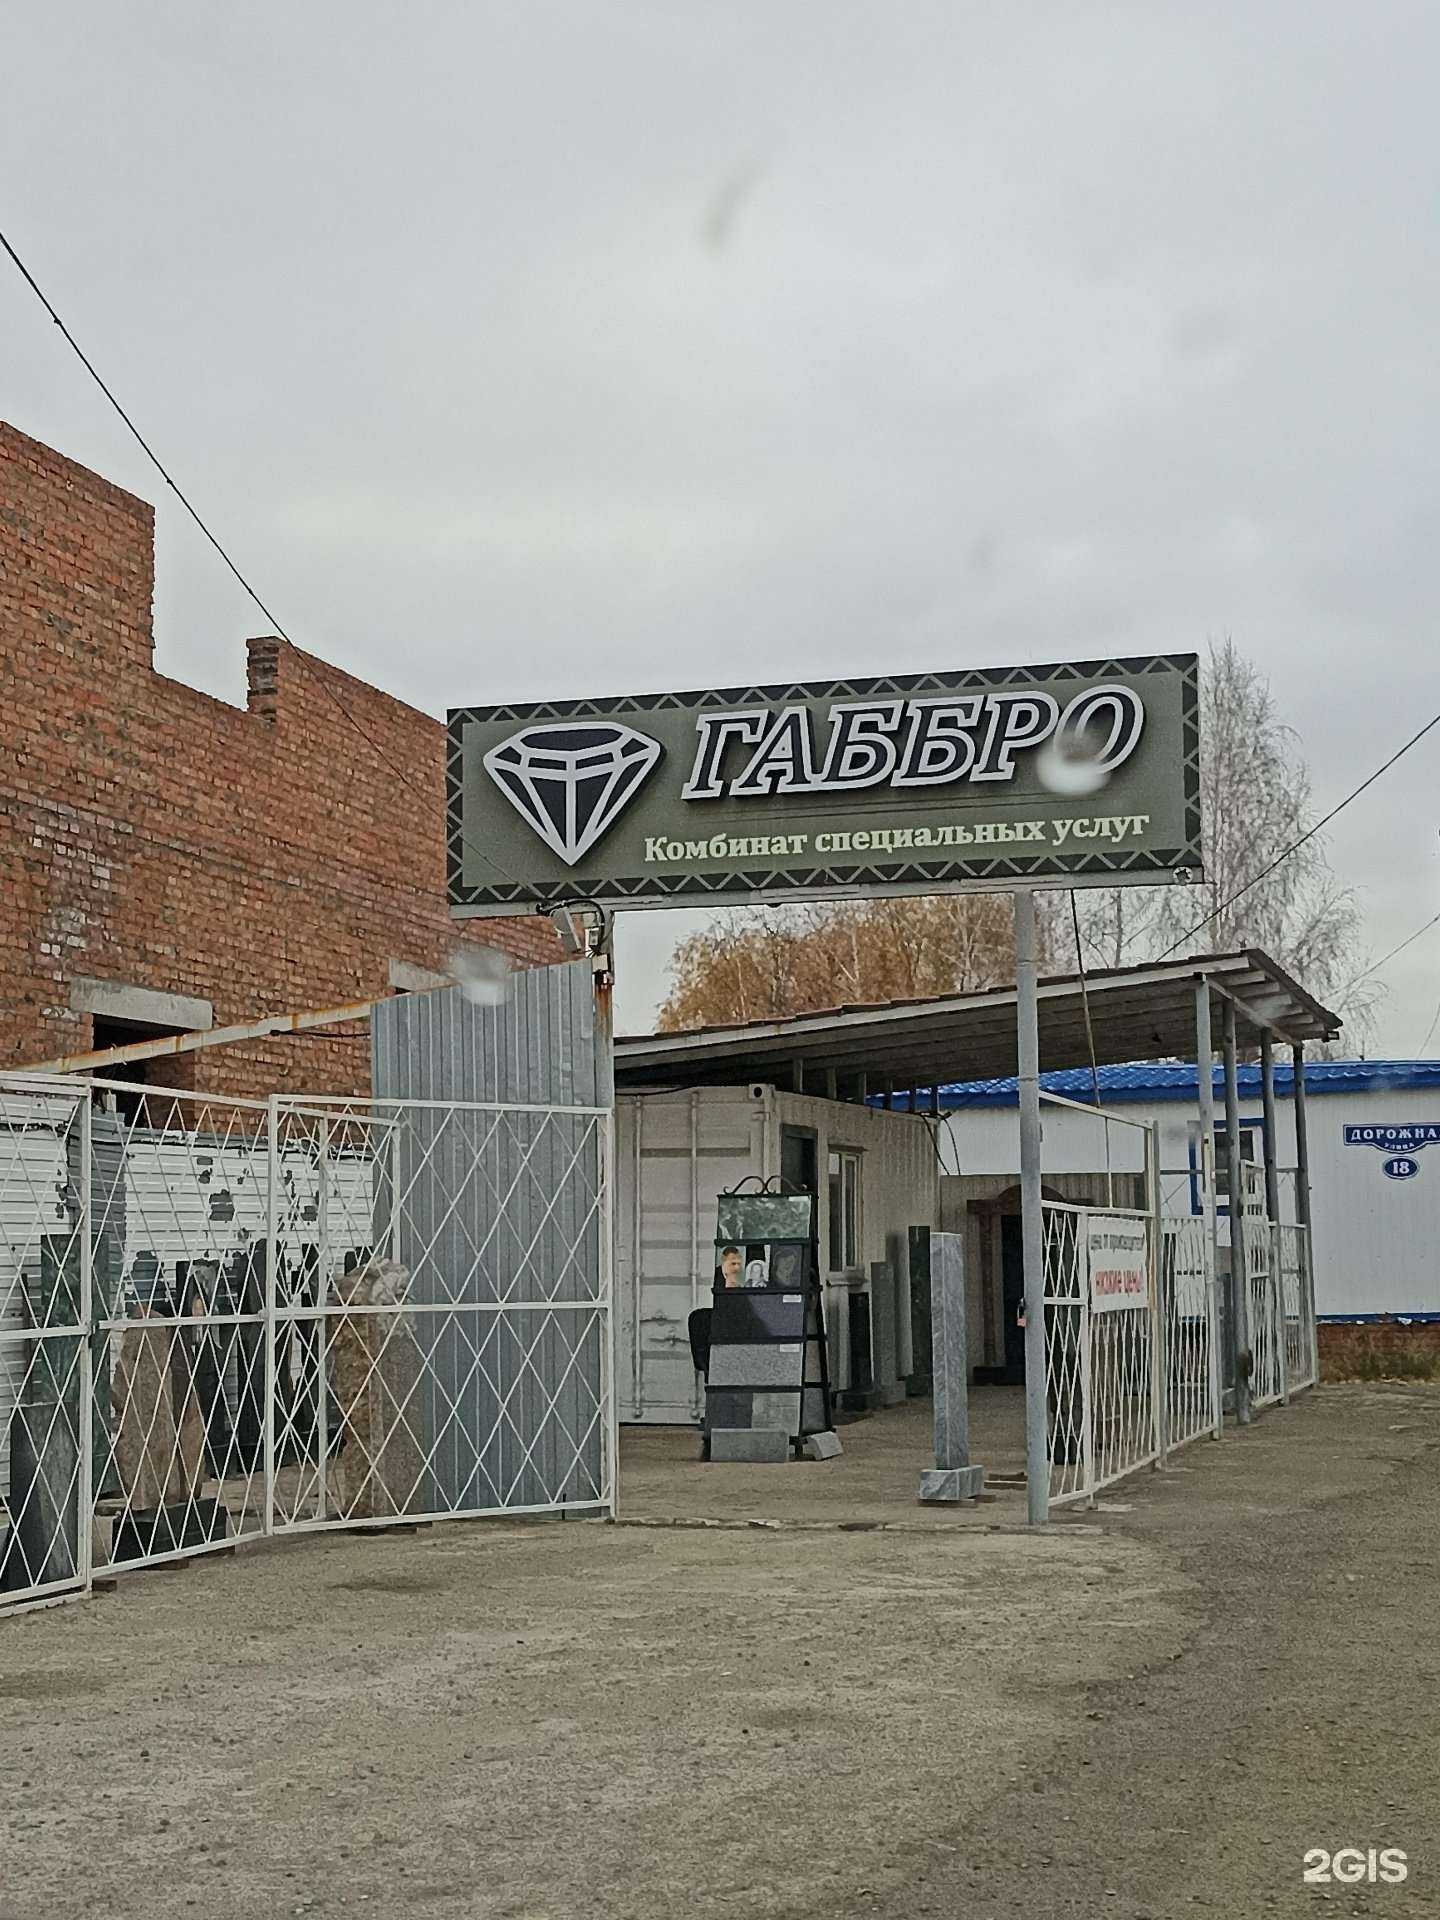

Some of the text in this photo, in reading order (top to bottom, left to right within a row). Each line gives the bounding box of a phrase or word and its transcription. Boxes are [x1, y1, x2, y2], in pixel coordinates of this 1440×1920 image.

[682, 684, 1144, 799] ГАББРО
[645, 815, 1149, 861] Комбинат специальных услуг
[1351, 1128, 1440, 1140] ДОРОЖНА
[1393, 1161, 1409, 1174] 18
